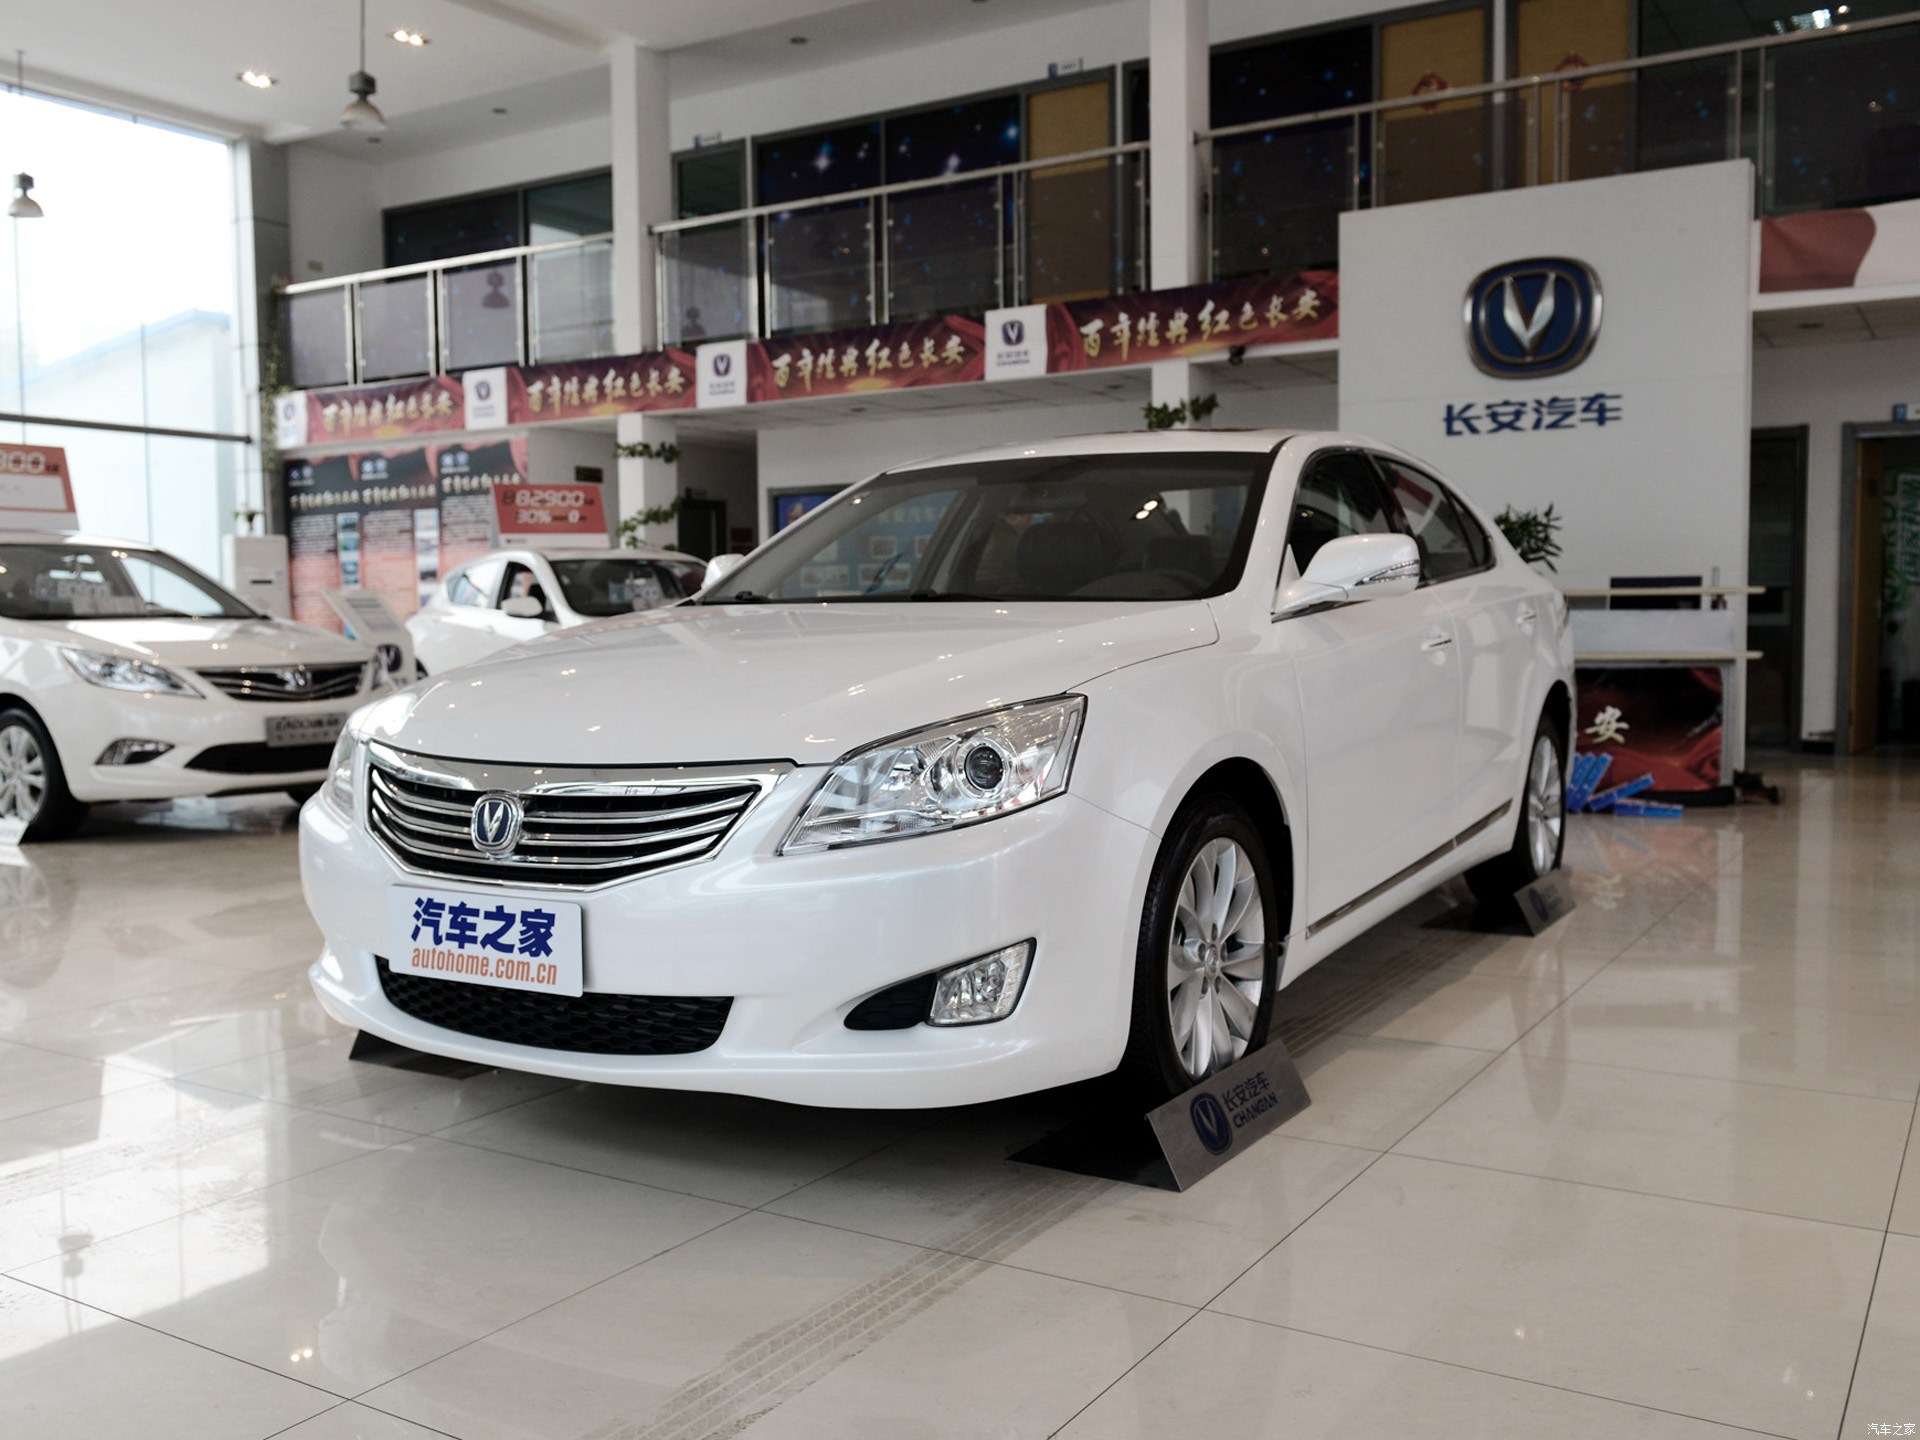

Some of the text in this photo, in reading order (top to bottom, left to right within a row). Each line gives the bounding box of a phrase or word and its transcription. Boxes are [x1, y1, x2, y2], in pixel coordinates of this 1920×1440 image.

[1443, 393, 1623, 436] 长安汽车
[1585, 705, 1630, 744] 安
[411, 897, 556, 958] 汽车之家
[411, 947, 558, 985] autohome.com.cn
[1221, 1071, 1270, 1112] 长安汽车
